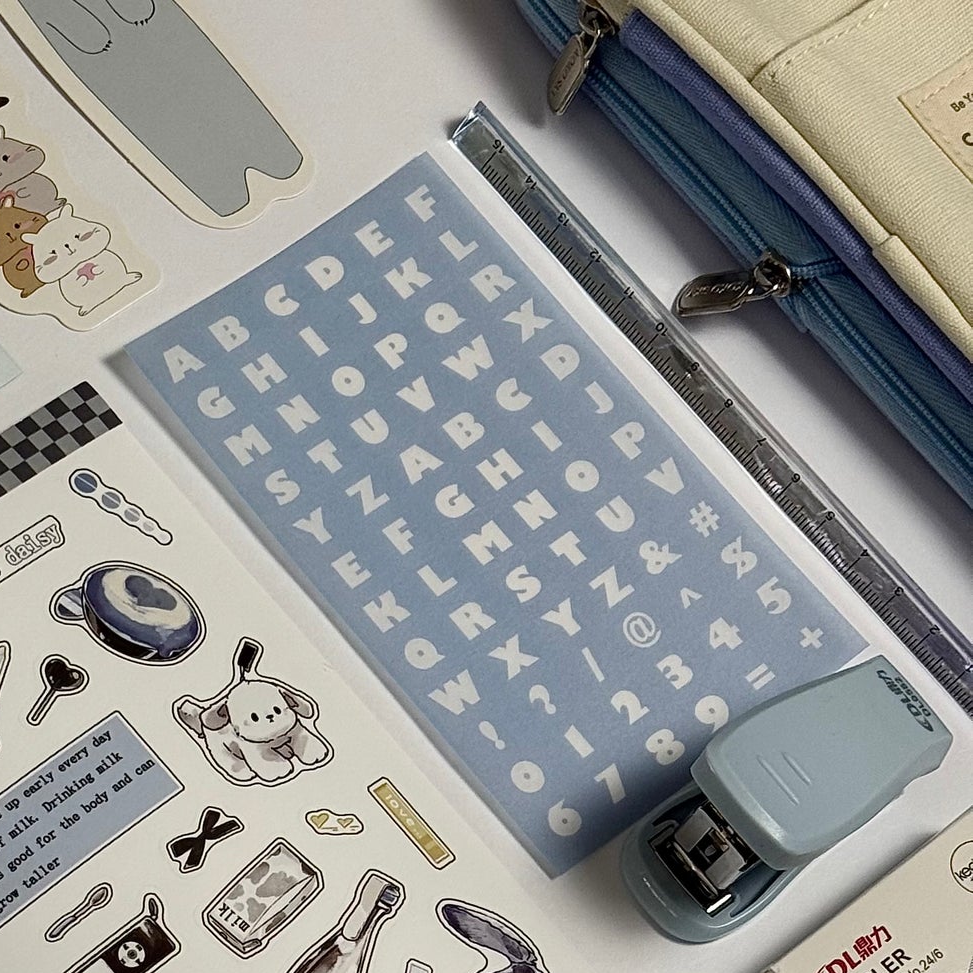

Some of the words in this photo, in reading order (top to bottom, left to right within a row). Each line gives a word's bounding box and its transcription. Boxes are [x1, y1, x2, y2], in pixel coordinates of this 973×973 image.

[949, 97, 965, 113] Be
[162, 345, 205, 386] A
[209, 315, 250, 352] B
[264, 284, 301, 318] C
[306, 256, 346, 293] D
[355, 221, 395, 258] E
[405, 186, 437, 225] F
[196, 387, 235, 421] G
[243, 354, 287, 395] H
[349, 293, 378, 327] J
[385, 258, 432, 301] K
[440, 231, 479, 263] L
[223, 425, 272, 469] M
[277, 396, 321, 435] N
[375, 333, 409, 370] P
[424, 303, 463, 336] Q
[471, 266, 516, 304] R
[265, 470, 302, 506] S
[308, 441, 341, 474] T
[351, 411, 390, 446] U
[399, 377, 437, 413] V
[443, 336, 495, 383] W
[505, 300, 550, 342] X
[5, 523, 62, 566] daisy
[404, 639, 443, 671] Q
[451, 603, 496, 640] R
[505, 566, 542, 604] S
[551, 532, 587, 567] T
[596, 497, 636, 535] U
[646, 458, 685, 497] V
[611, 690, 651, 724] 2
[657, 655, 694, 692] 3
[709, 619, 743, 650] 4
[757, 578, 793, 616] 5
[4, 797, 20, 812] up
[22, 770, 55, 798] early
[58, 745, 90, 773] every
[92, 728, 112, 748] day
[7, 847, 34, 873] good
[36, 831, 57, 848] for
[59, 812, 81, 830] the
[81, 789, 109, 815] body
[112, 773, 132, 792] and
[135, 759, 155, 776] can
[9, 815, 39, 840] milk.
[41, 771, 95, 813] Drinking
[96, 752, 124, 775] milk
[22, 856, 61, 888] taller
[219, 903, 250, 933] milk
